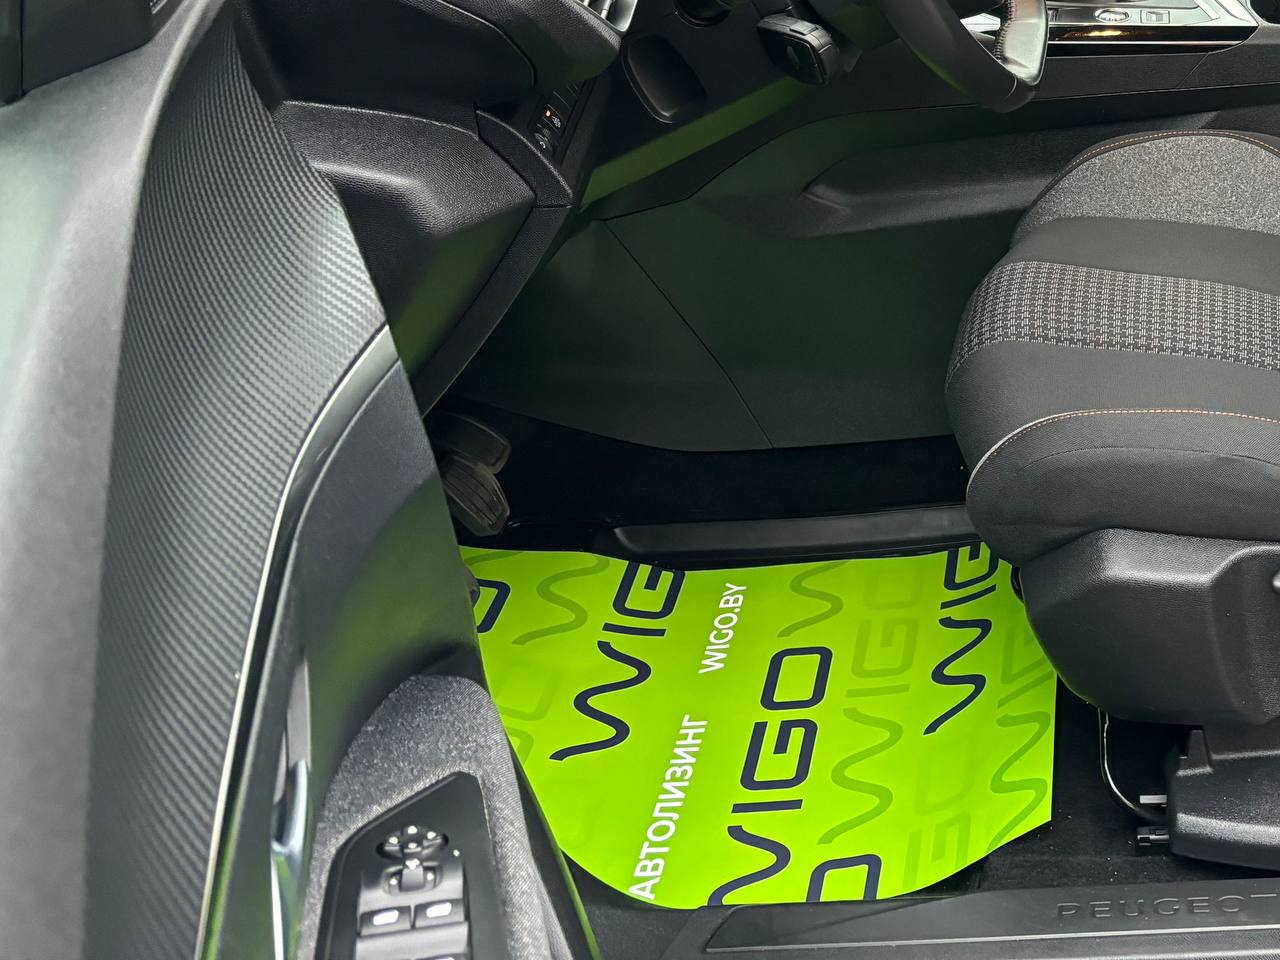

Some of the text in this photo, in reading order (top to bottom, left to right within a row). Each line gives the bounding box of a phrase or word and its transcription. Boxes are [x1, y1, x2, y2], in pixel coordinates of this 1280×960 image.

[549, 561, 686, 761] WIG
[699, 583, 747, 673] WIGO.BY
[923, 540, 999, 735] WIG
[628, 714, 708, 901] АВТОЛИЗИНГ
[1057, 893, 1278, 918] PEUGEOT
